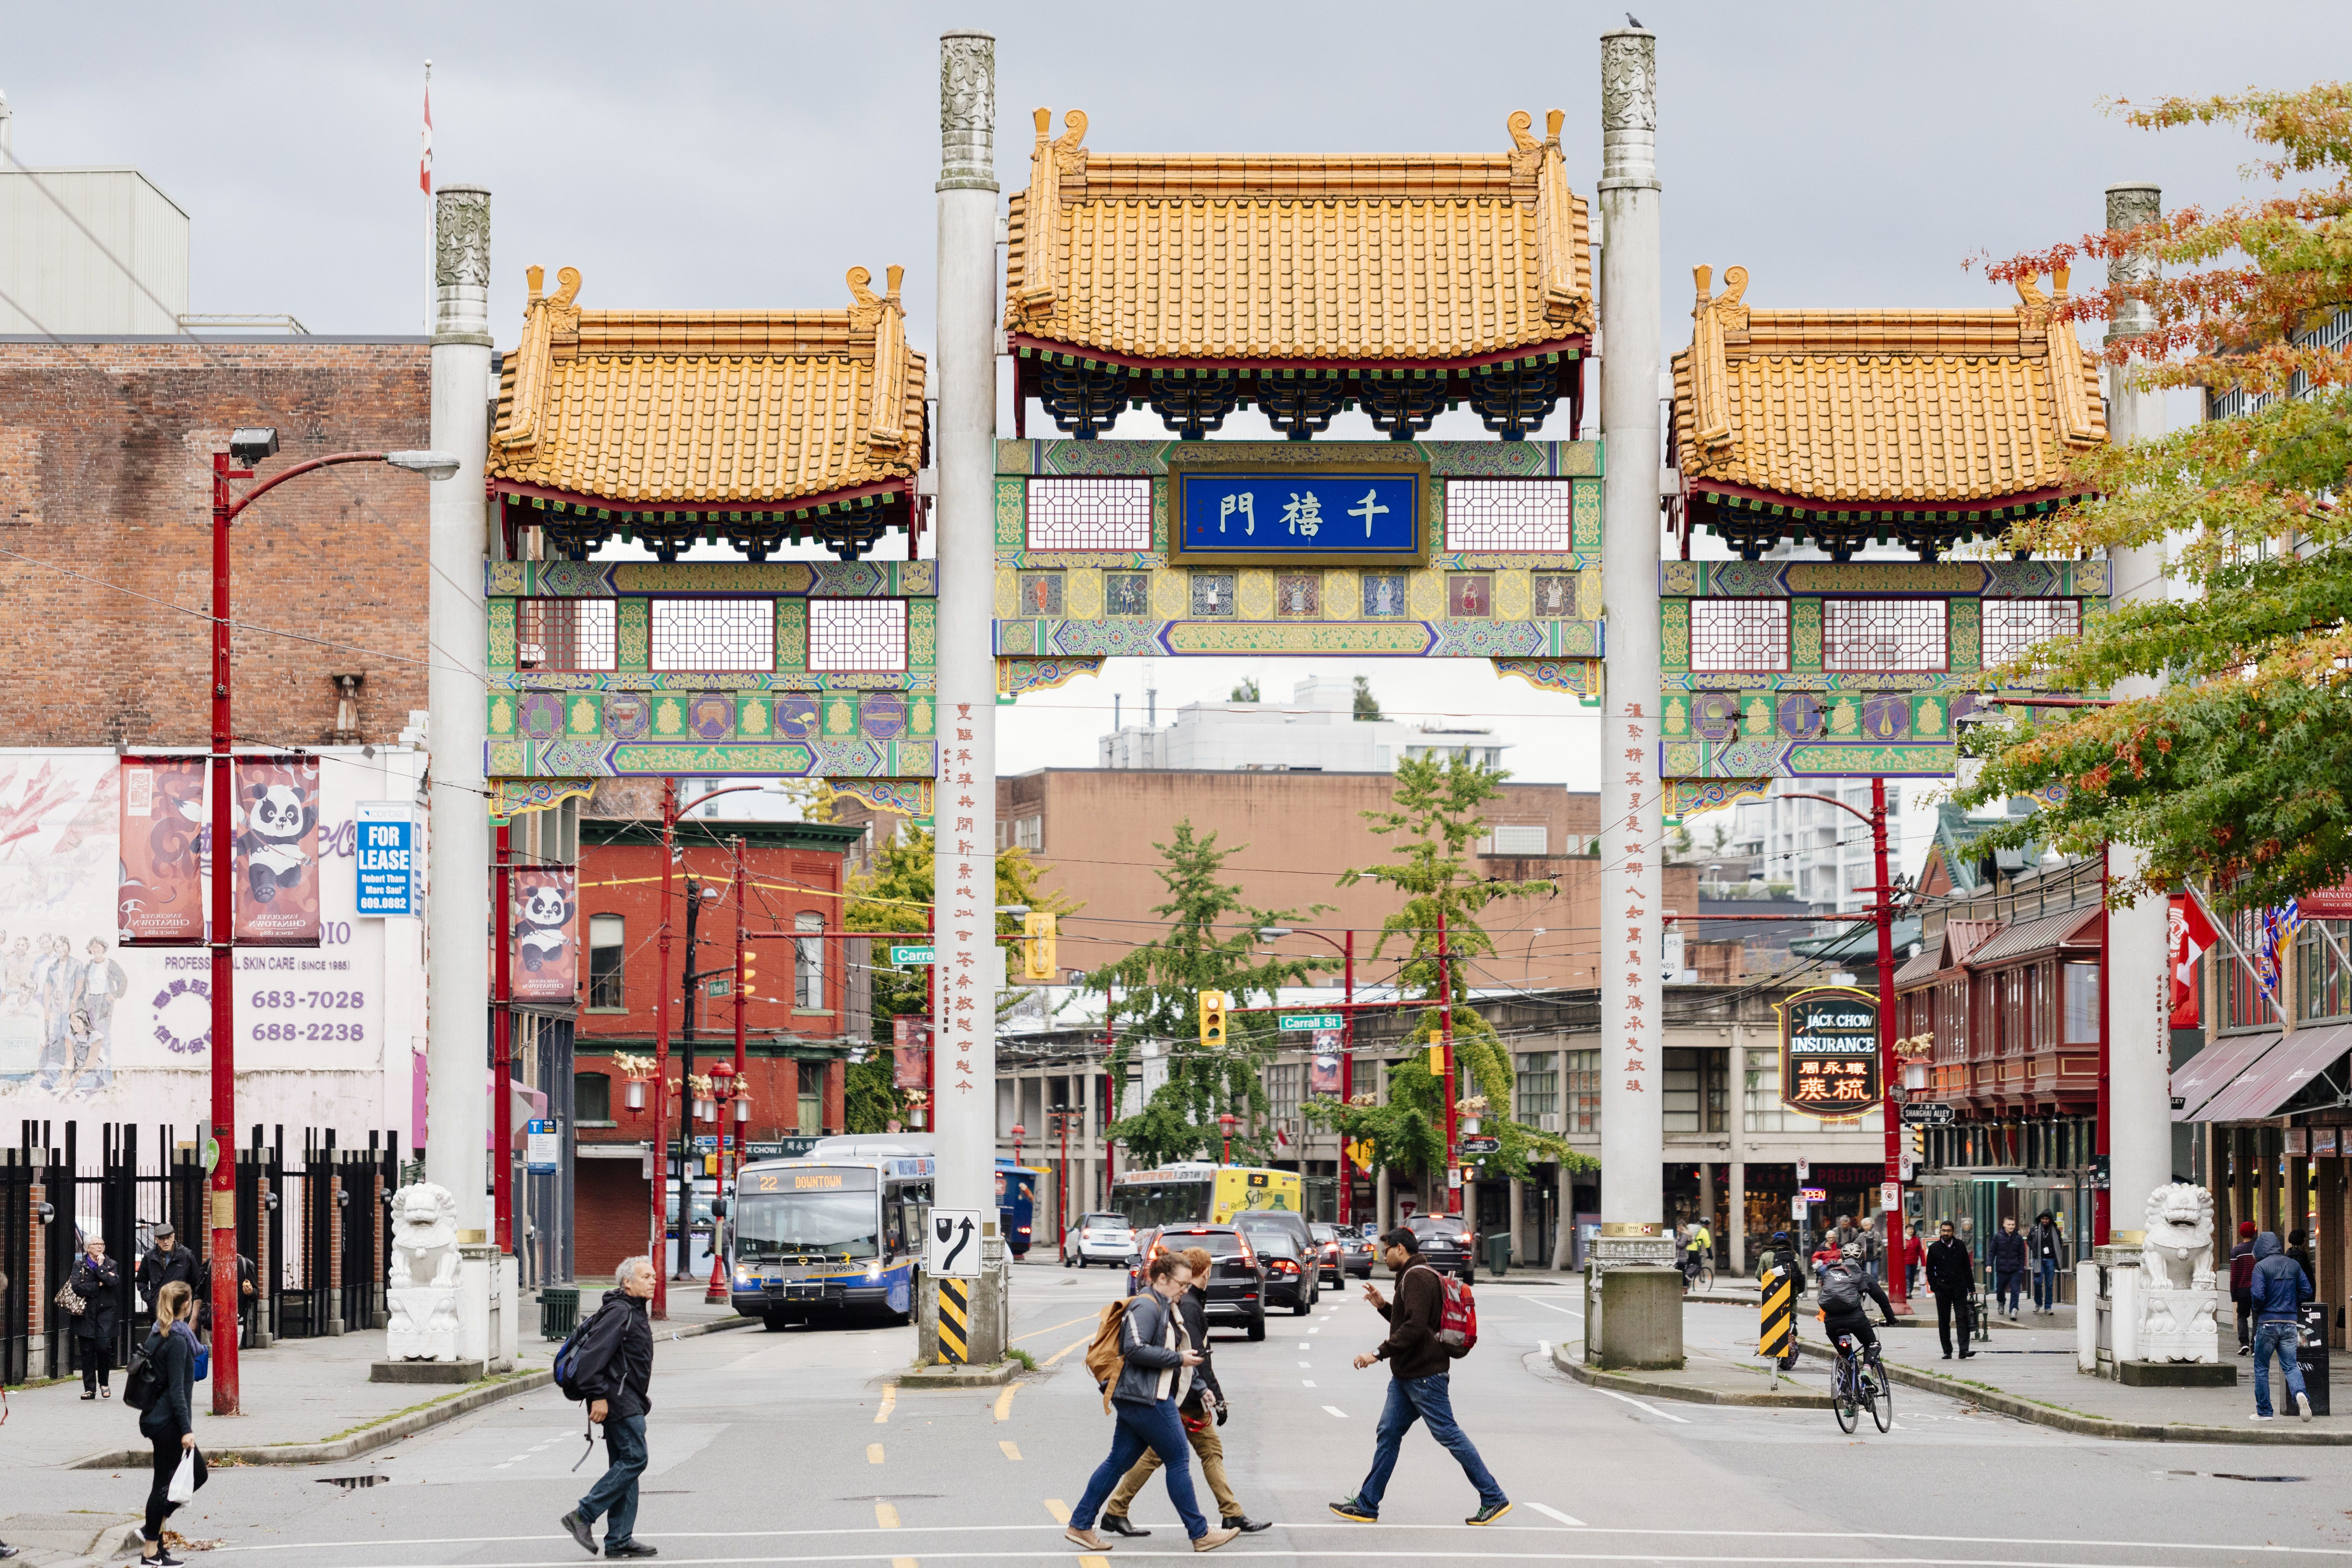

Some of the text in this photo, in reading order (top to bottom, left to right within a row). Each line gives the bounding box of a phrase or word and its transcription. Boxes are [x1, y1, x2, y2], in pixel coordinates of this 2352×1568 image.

[1219, 489, 1390, 538] 千禧門
[368, 826, 400, 847] FOR
[358, 850, 409, 870] LEASE
[362, 874, 406, 883] Robert Tham
[365, 886, 384, 894] Marc
[361, 897, 406, 909] 609.0882
[243, 957, 266, 970] SKIN
[269, 957, 295, 970] CARE
[252, 991, 364, 1008] 683-7028
[1285, 1017, 1337, 1028] Carrall St
[1806, 1015, 1874, 1029] JACK CHOW
[252, 1023, 364, 1041] 688-2238
[1791, 1037, 1876, 1052] INSURANCE
[1905, 1109, 1950, 1117] SHANGHAI ALLEY
[760, 1175, 842, 1190] 22 DOWNTOWN
[1254, 1176, 1263, 1184] 22
